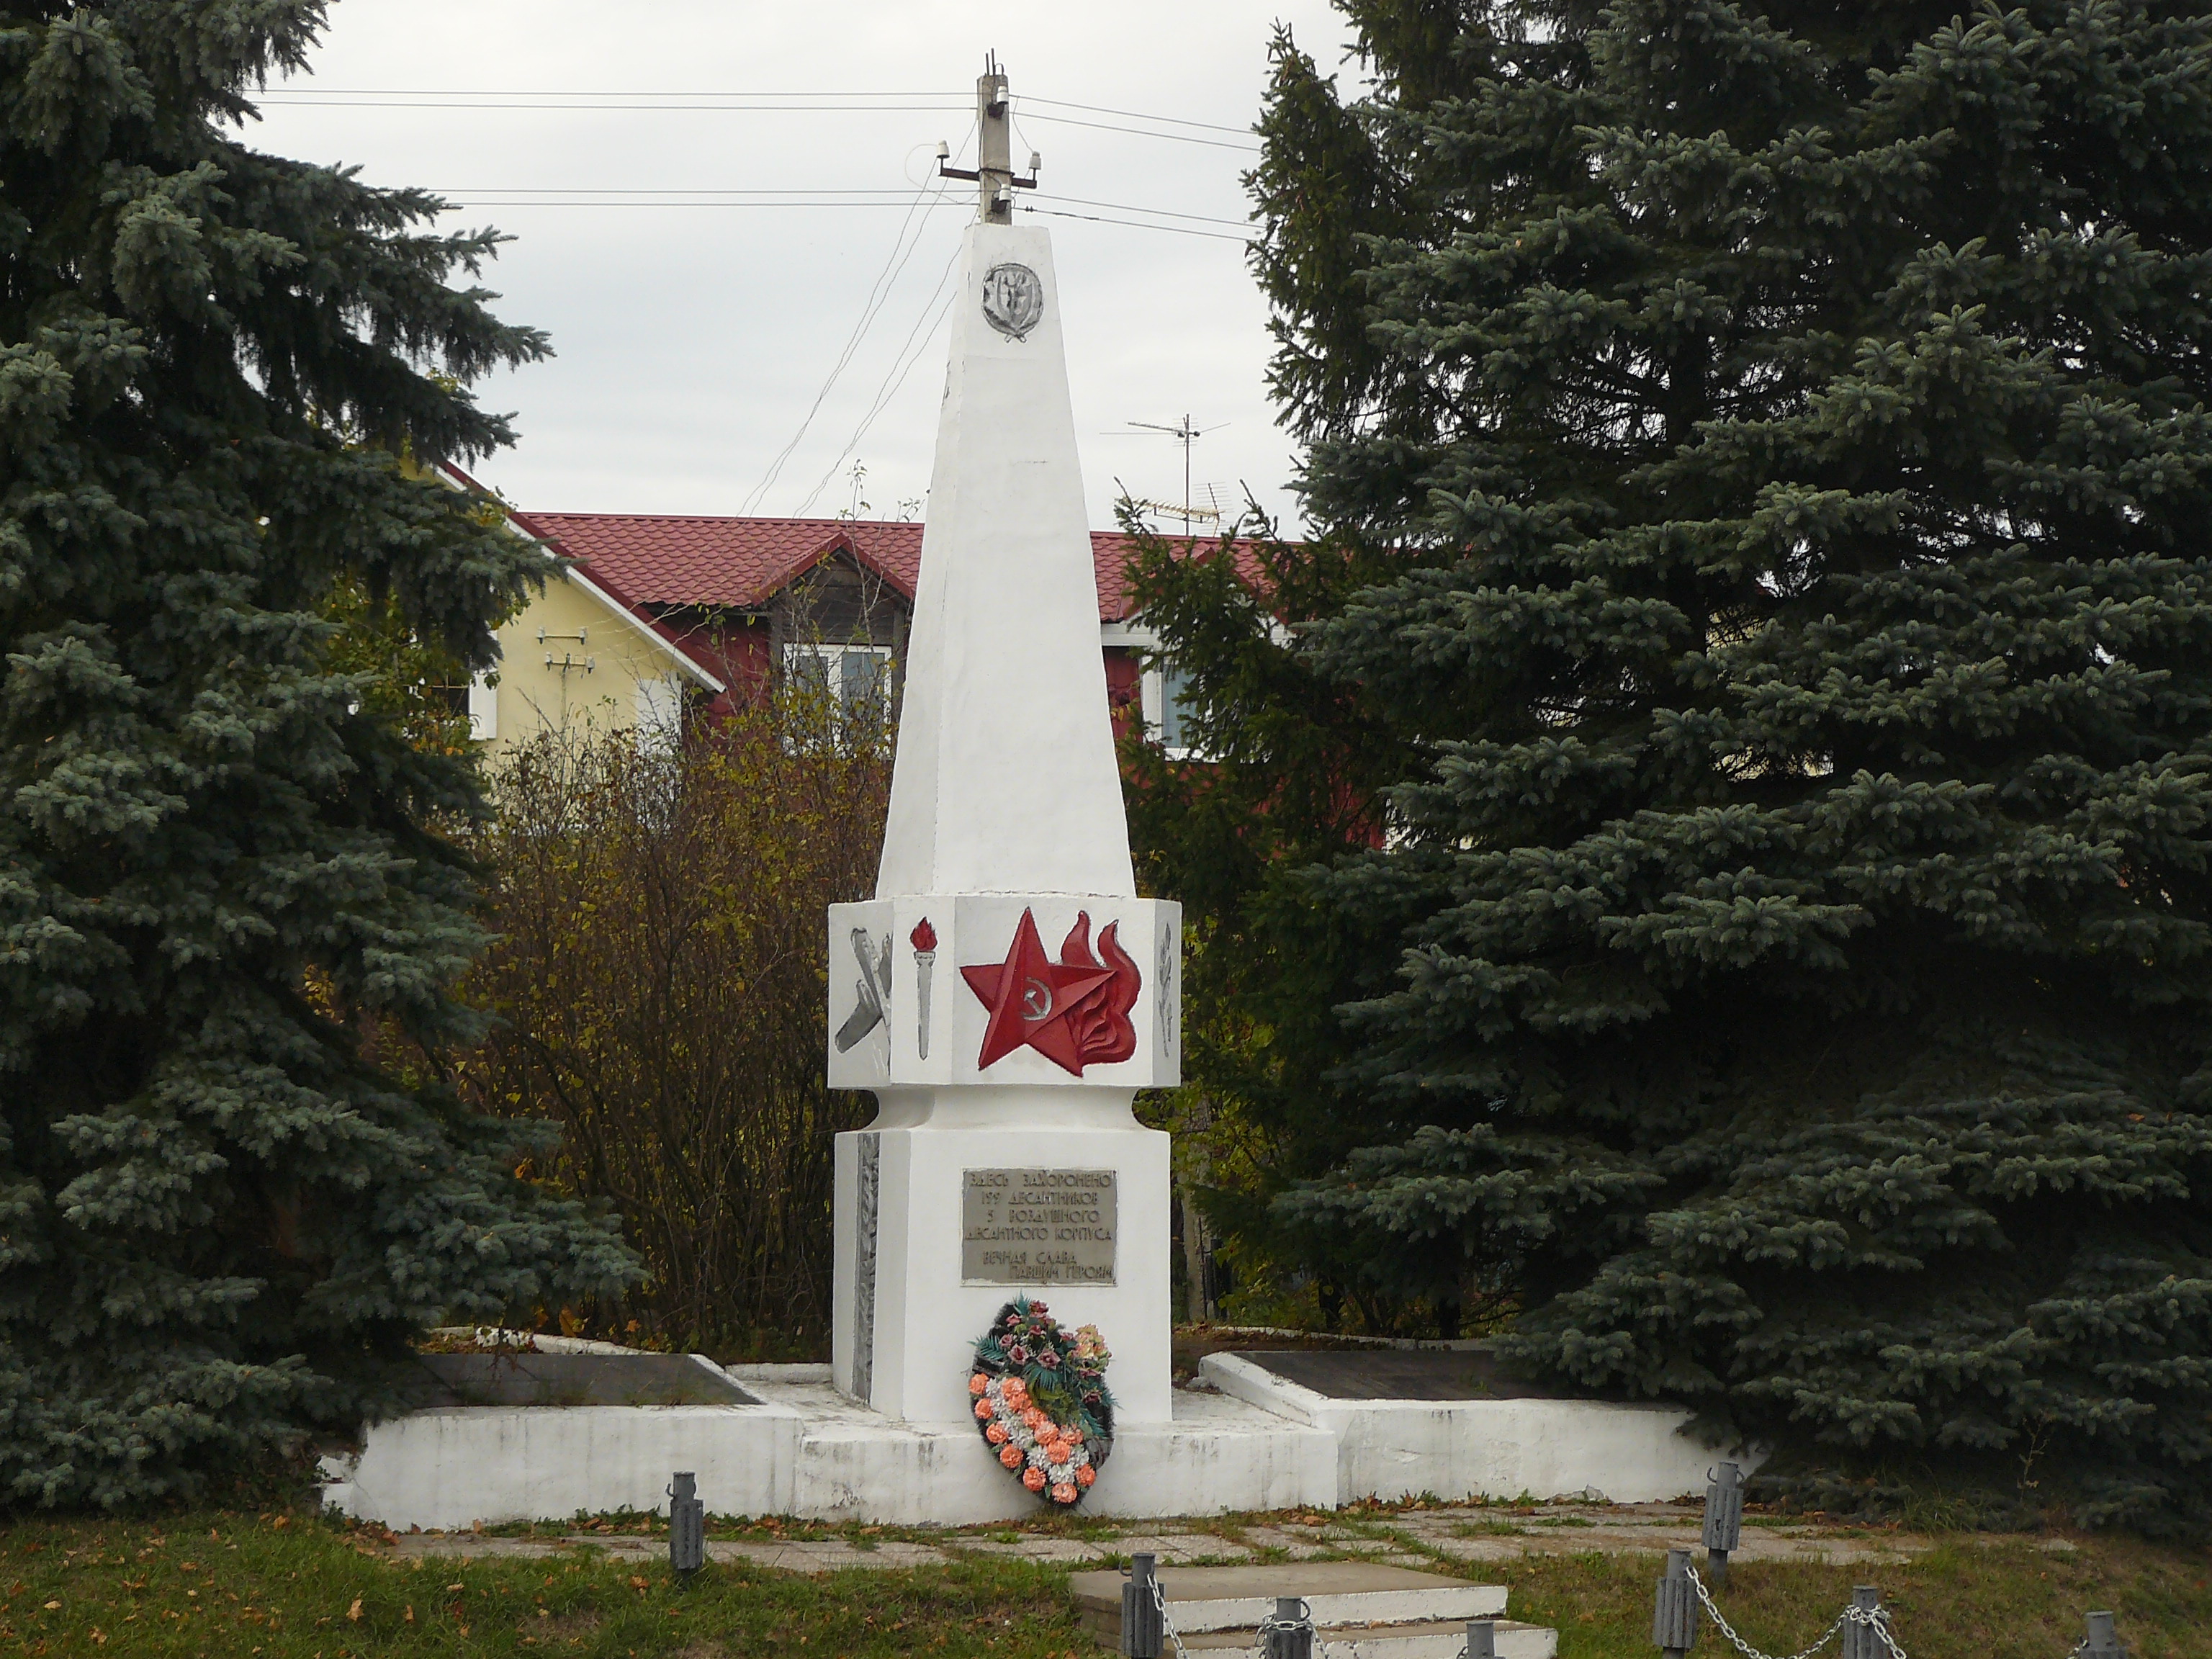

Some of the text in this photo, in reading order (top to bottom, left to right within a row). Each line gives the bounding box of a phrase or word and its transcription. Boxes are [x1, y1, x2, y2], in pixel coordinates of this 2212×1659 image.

[970, 1173, 1112, 1187] ЗДЕСЬ ЗАХОРОНЕНО
[1008, 1191, 1098, 1205] ДЕСАНТНИКОВ
[1010, 1209, 1100, 1223] ВОЗДУШНОГО
[965, 1227, 1112, 1241] ДЕСАНТНОГО КОРПУСА
[983, 1250, 1077, 1264] ВЕЧНАЯ СЛАВА
[1010, 1265, 1113, 1280] ПАВШИМ ГЕРОЯМ
